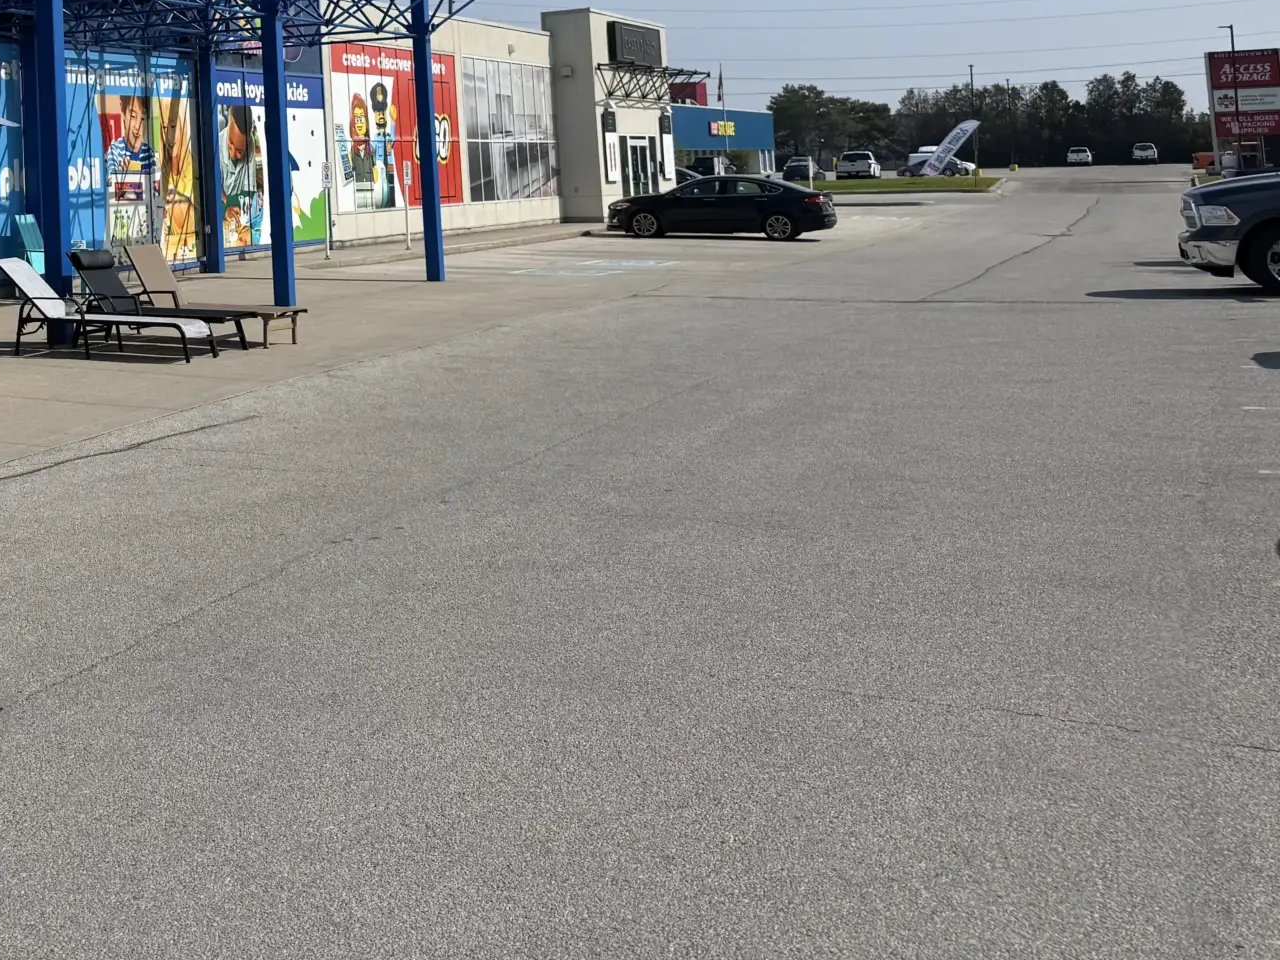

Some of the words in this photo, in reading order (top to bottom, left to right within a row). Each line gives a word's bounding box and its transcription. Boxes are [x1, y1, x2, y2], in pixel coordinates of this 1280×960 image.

[342, 53, 370, 68] create
[377, 52, 411, 72] discover
[1220, 63, 1271, 75] ACCESS
[66, 61, 156, 91] imagination
[1220, 72, 1272, 82] STORAGE
[286, 81, 309, 101] kids
